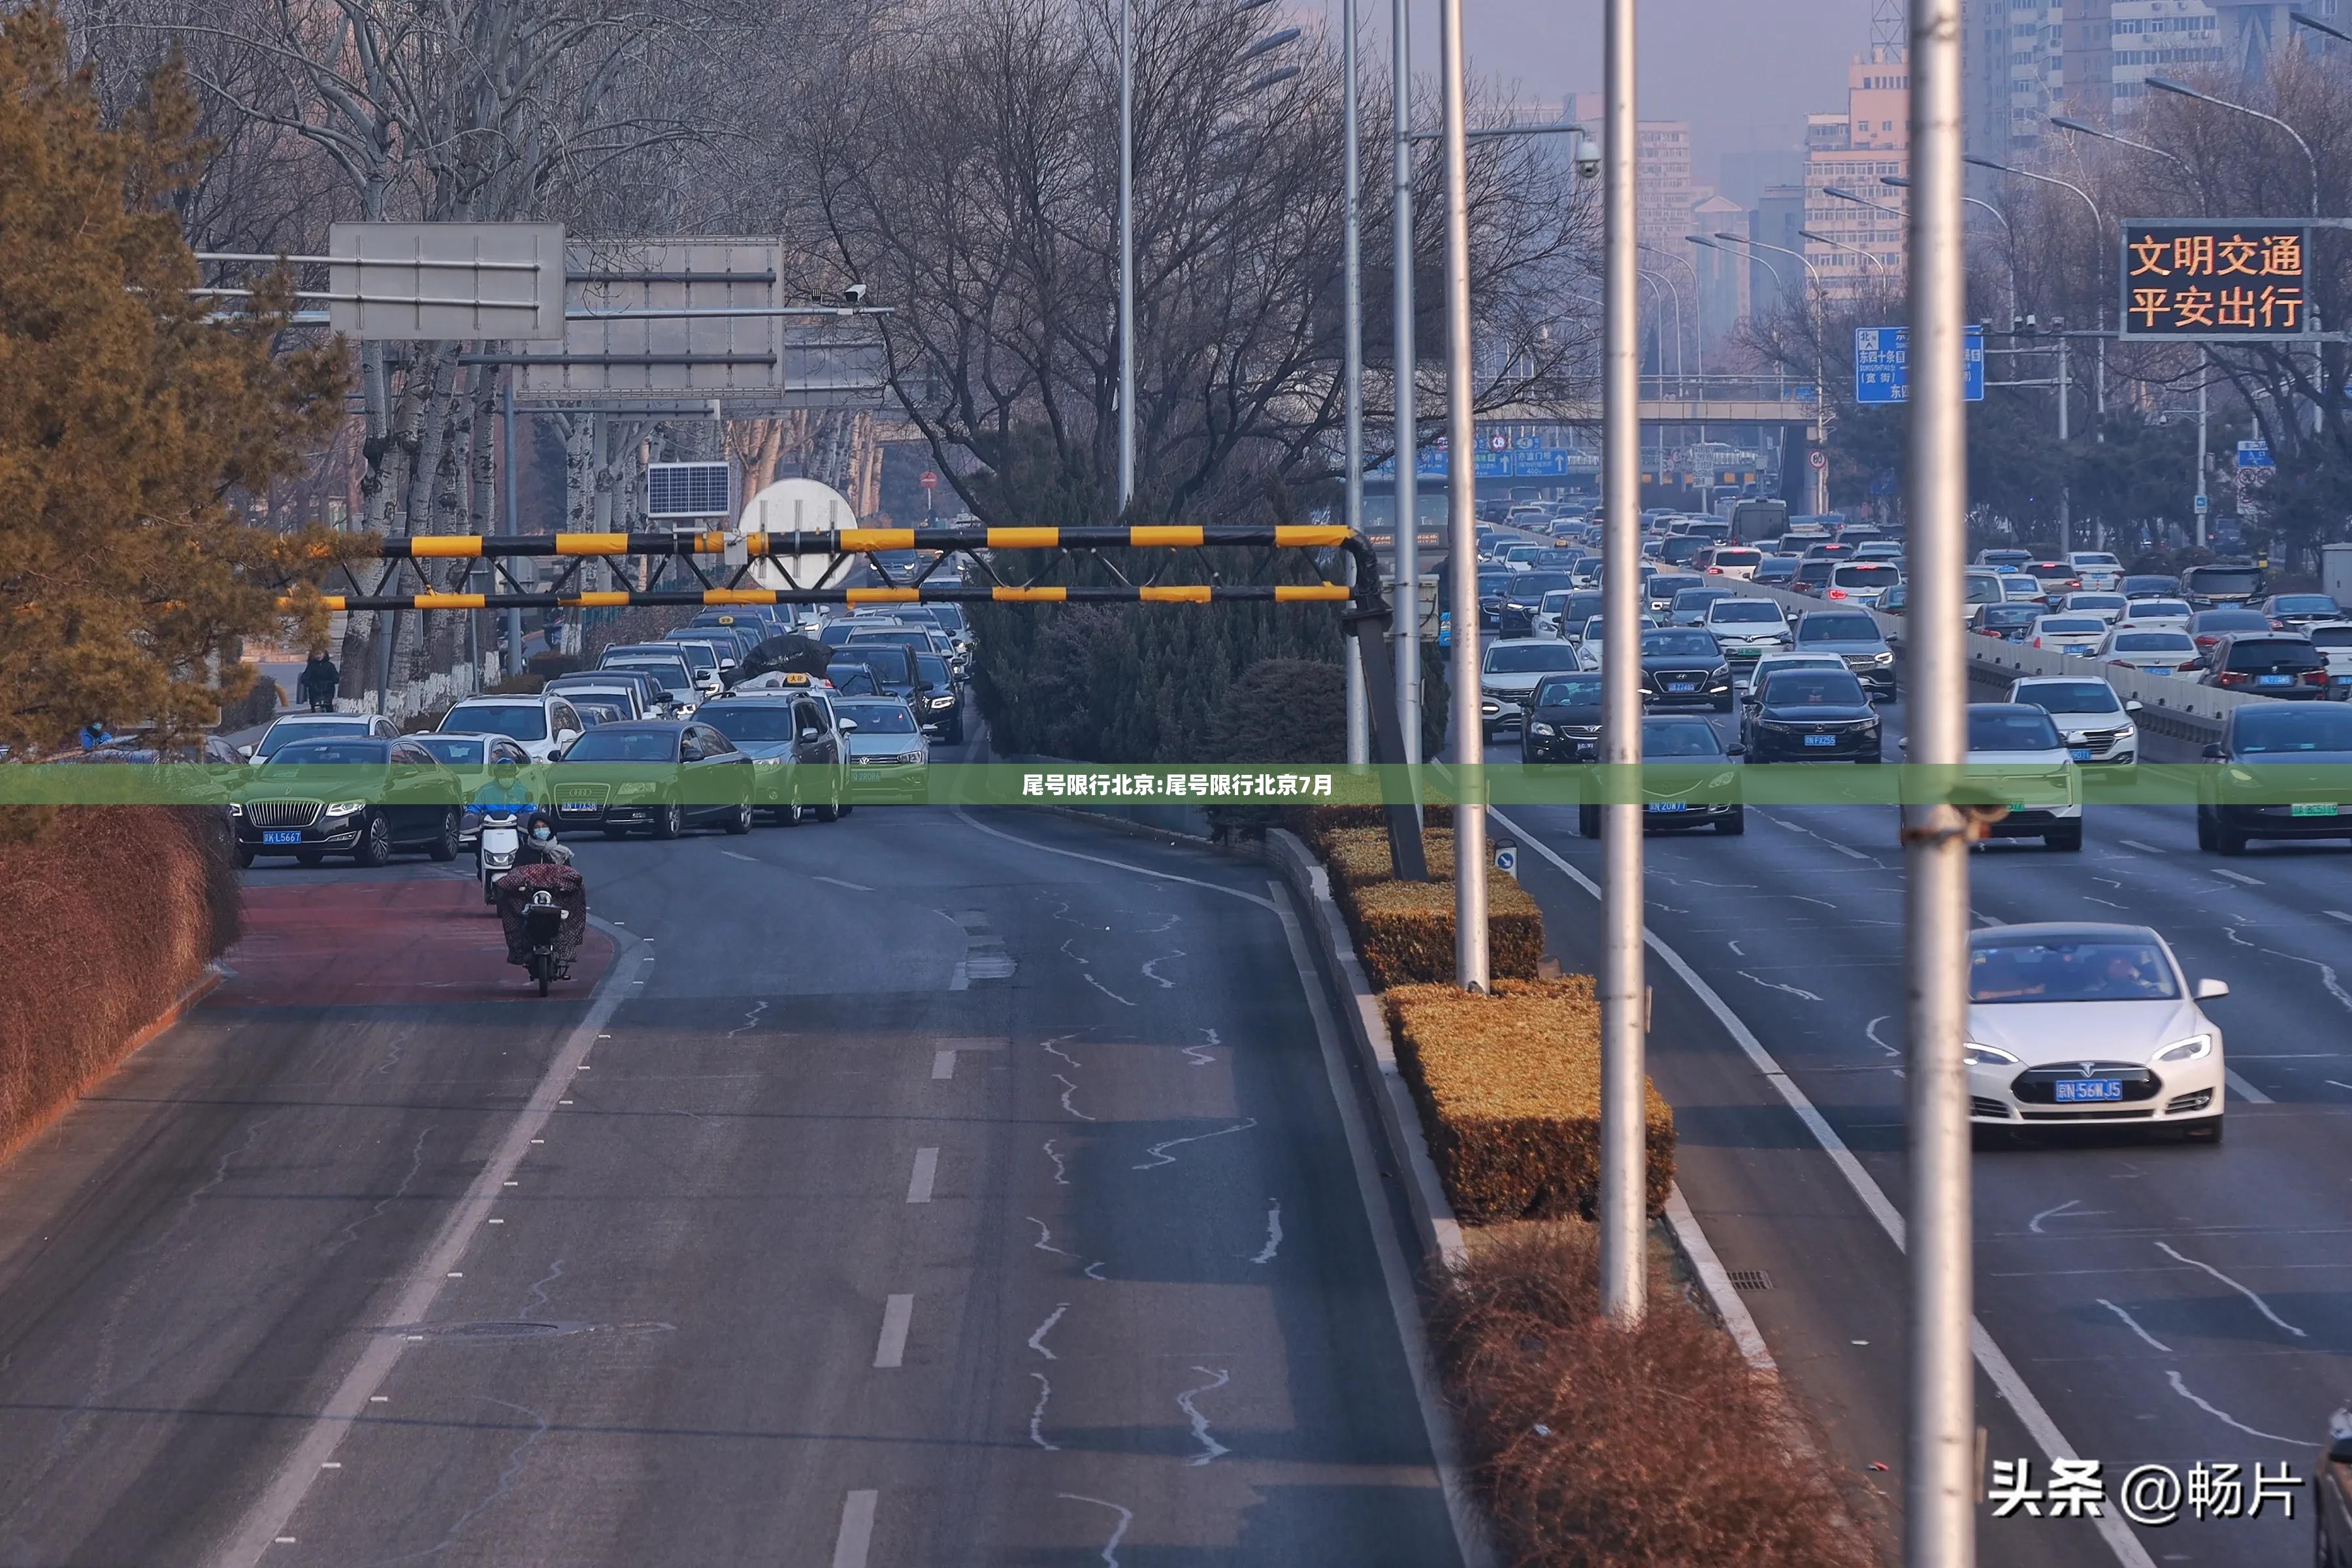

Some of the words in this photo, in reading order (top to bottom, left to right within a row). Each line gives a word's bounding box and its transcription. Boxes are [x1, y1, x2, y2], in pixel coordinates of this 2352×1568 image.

[2129, 233, 2302, 276] 文明交通
[2129, 285, 2303, 327] 平安出行
[1860, 331, 1870, 342] 北
[1859, 350, 1895, 364] 东四十条
[1813, 454, 1823, 464] 80
